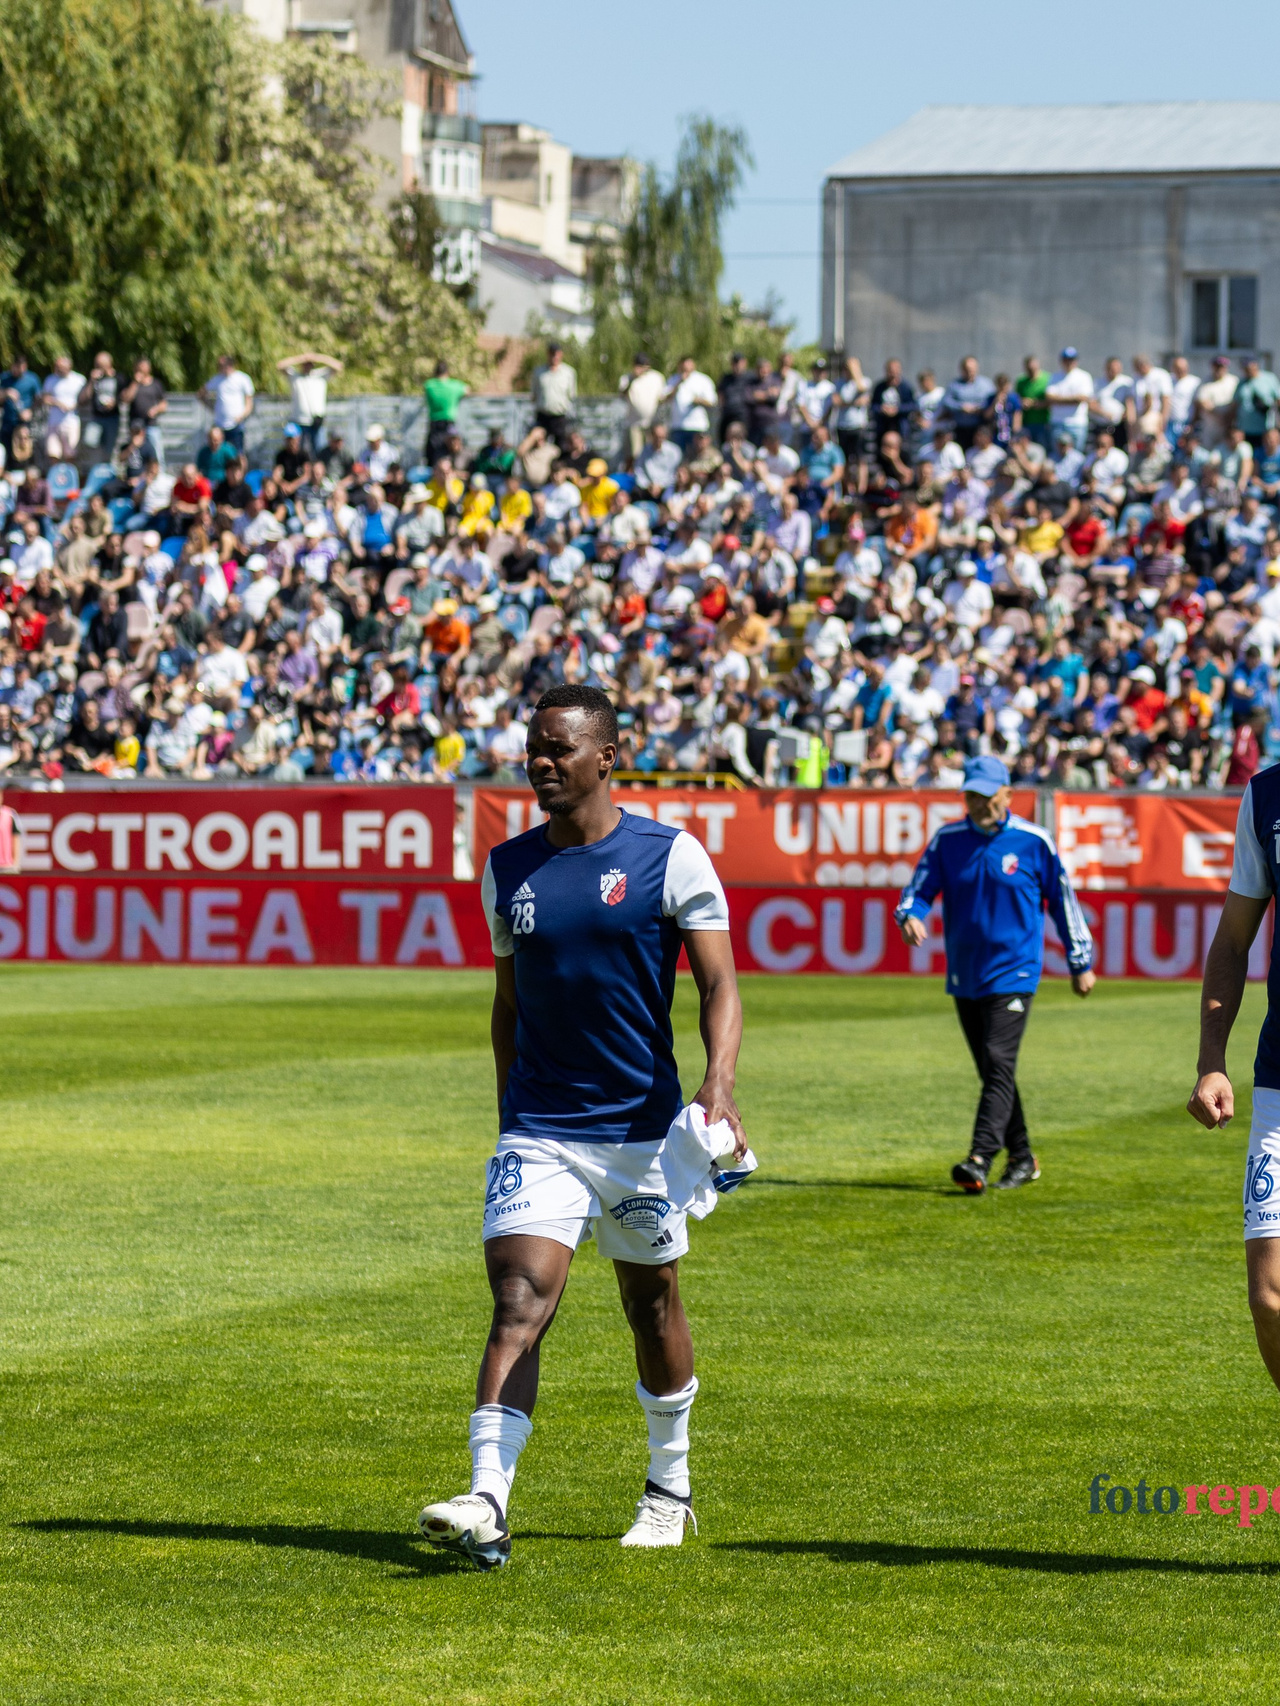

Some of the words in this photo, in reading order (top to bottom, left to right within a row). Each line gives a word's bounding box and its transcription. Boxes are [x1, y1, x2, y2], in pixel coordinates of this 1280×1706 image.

[512, 892, 536, 901] adidas
[339, 890, 466, 966] TA
[511, 902, 535, 934] 28
[748, 896, 889, 973] CU
[486, 1151, 523, 1206] 28
[1245, 1154, 1274, 1203] 16
[494, 1200, 531, 1217] Vestra
[626, 1199, 669, 1214] CONTINENTS
